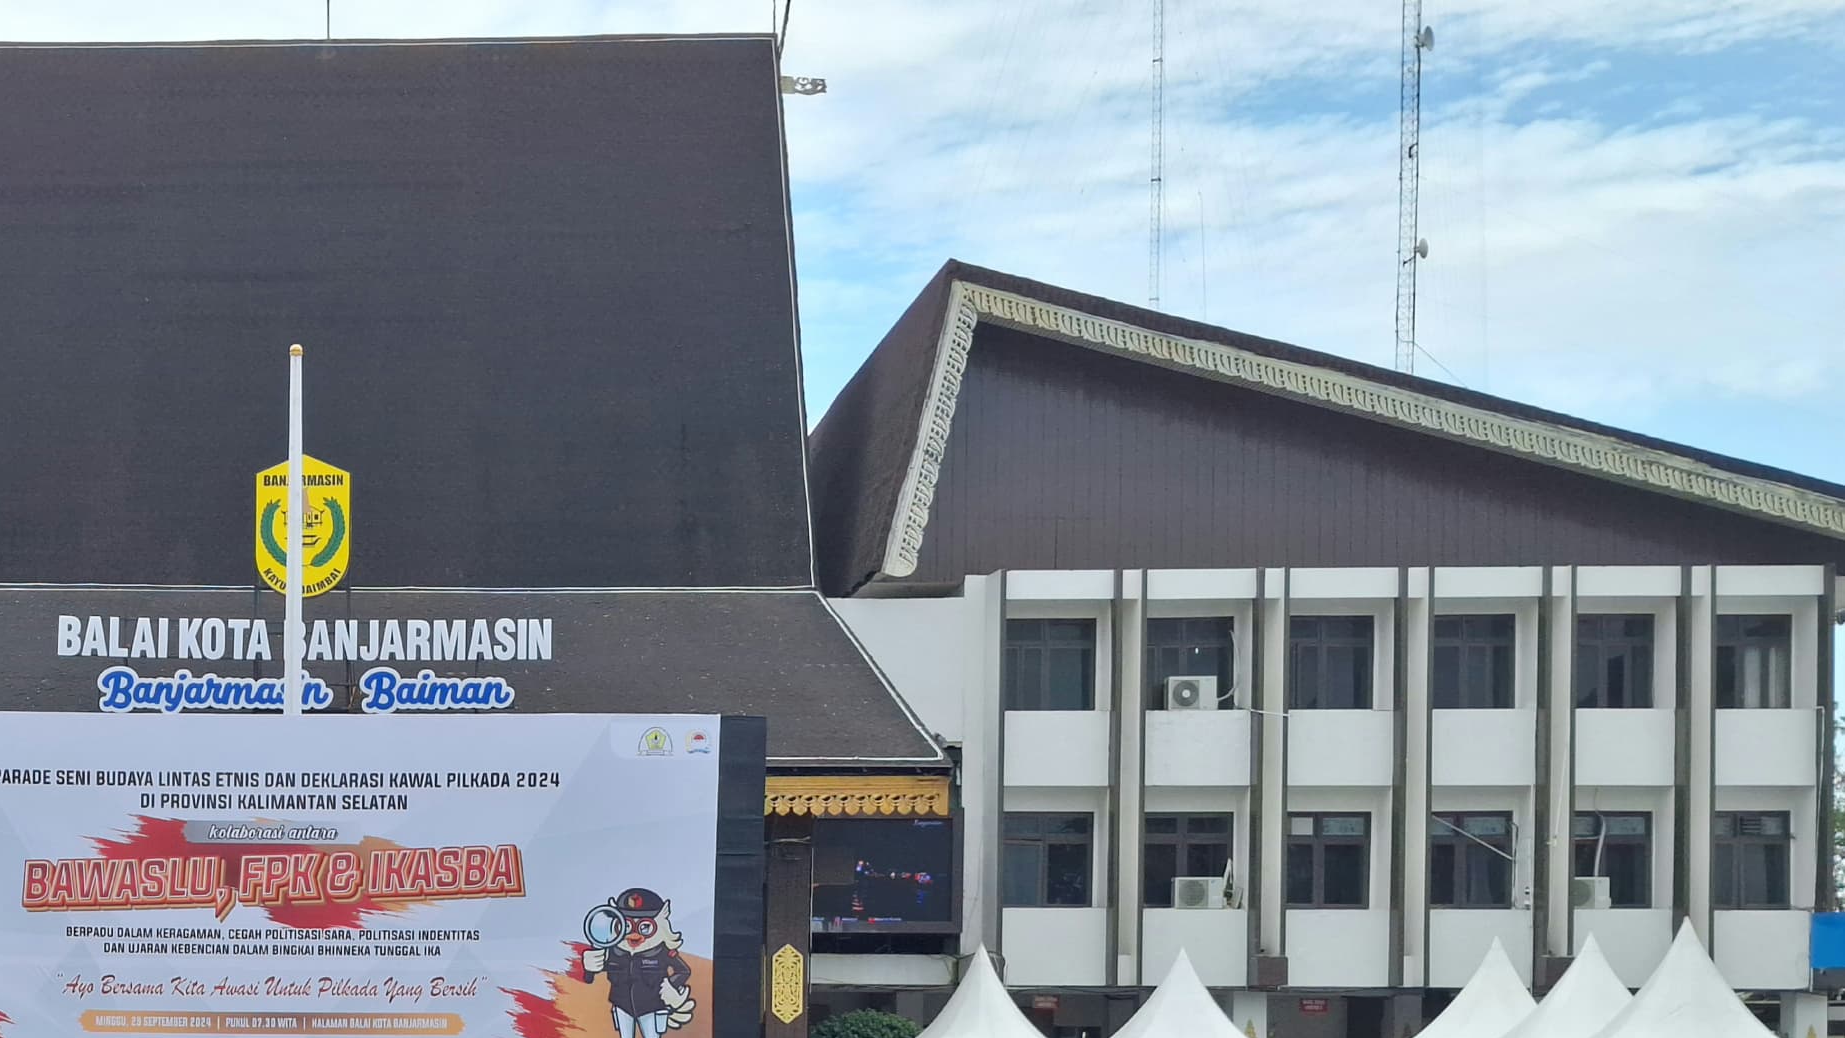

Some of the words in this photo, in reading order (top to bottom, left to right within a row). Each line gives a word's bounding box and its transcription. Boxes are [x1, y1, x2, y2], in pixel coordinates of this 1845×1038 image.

[263, 474, 344, 486] BANRMASIN
[263, 567, 287, 590] KAYU
[57, 615, 168, 659] BALAI
[179, 617, 272, 660] KOTA
[100, 668, 332, 712] Banjarmasn
[362, 668, 512, 711] Baiman
[56, 770, 91, 786] SENI
[96, 770, 153, 787] BUDAYA
[158, 771, 211, 787] LINTAS
[215, 772, 260, 788] ETNIS
[265, 772, 296, 788] DAN
[301, 772, 384, 788] DEKLARASI
[389, 772, 442, 788] KAWAL
[447, 772, 510, 788] PILKADA
[516, 772, 560, 788] 2024
[141, 793, 155, 809] DI
[160, 794, 232, 810] PROVINSI
[238, 794, 336, 810] KALIMANTAN
[342, 794, 408, 810] SELATAN
[208, 824, 284, 840] kolaborasi
[288, 825, 338, 840] antara
[239, 852, 326, 906] FPK
[327, 850, 364, 902] &
[367, 844, 526, 901] IKASBA
[66, 926, 114, 938] BERPADU
[117, 927, 153, 939] DALAM
[228, 929, 262, 940] CEGAH
[265, 929, 322, 941] POLITISASI
[358, 930, 415, 942] POLITISASI
[418, 930, 480, 942] INDENTITAS
[104, 942, 125, 954] DAN
[128, 943, 168, 955] UJARAN
[171, 944, 230, 955] KEBENCIAN
[233, 944, 269, 956] DALAM
[272, 945, 315, 956] BINGKAI
[318, 945, 371, 957] BHINNEKA
[374, 945, 422, 957] TUNGGAL
[424, 945, 442, 957] IKA
[101, 974, 165, 997] Bersama
[170, 976, 206, 997] Kita
[210, 976, 260, 998] Awasi
[264, 976, 312, 998] Untuk
[316, 976, 379, 999] Pilkada
[384, 976, 424, 1003] Yang
[143, 1016, 188, 1028] SEPTEMBER
[190, 1016, 212, 1028] 2024
[226, 1017, 250, 1029] PUKUL
[277, 1018, 298, 1029] WITA
[312, 1018, 348, 1029] HALAMAN
